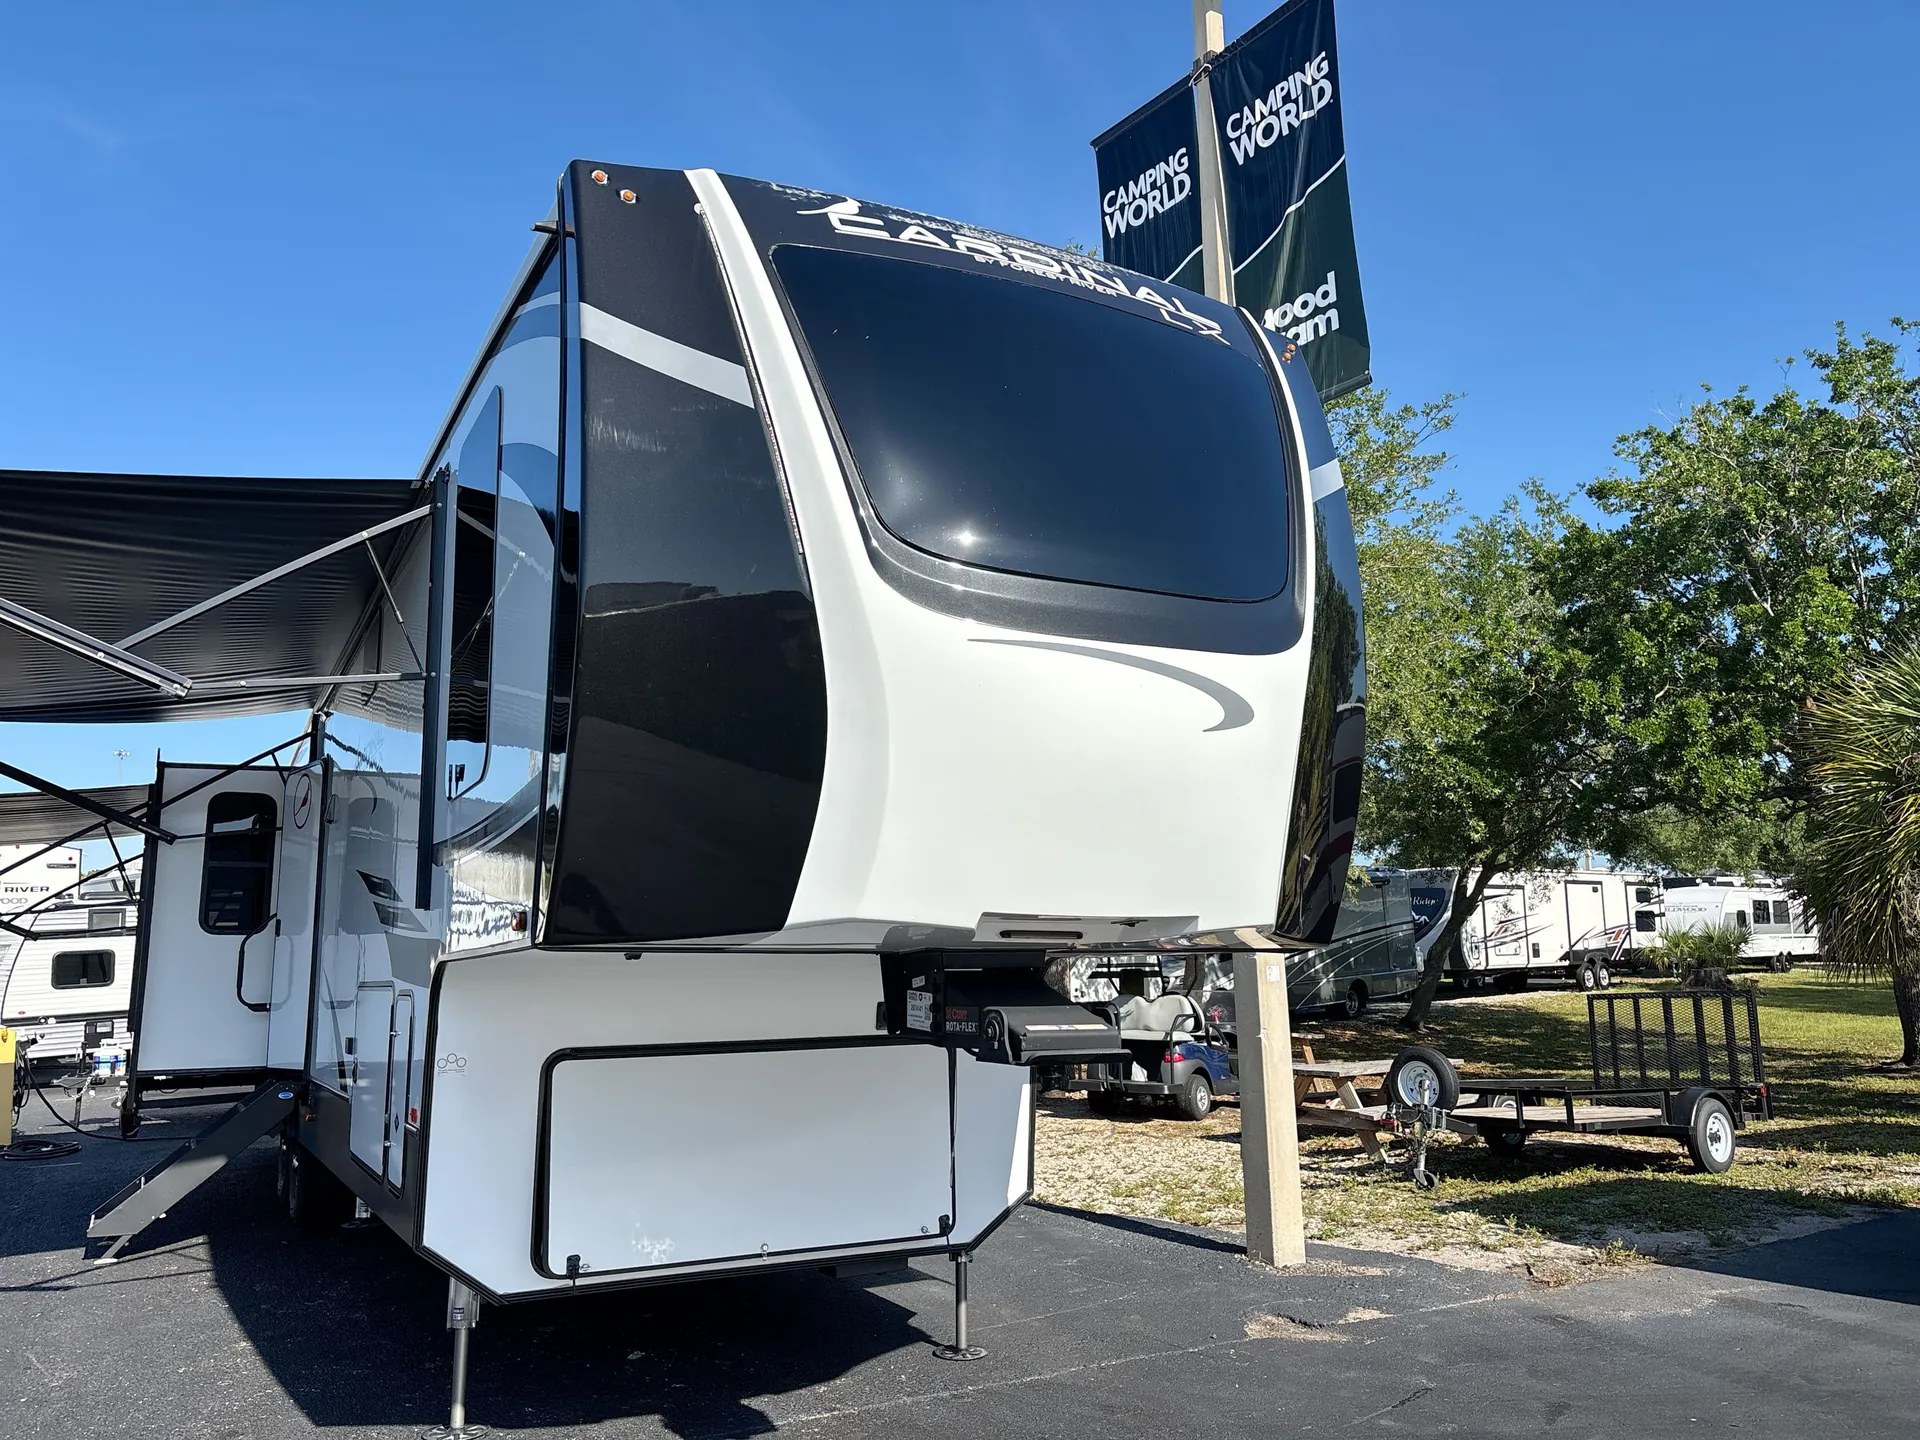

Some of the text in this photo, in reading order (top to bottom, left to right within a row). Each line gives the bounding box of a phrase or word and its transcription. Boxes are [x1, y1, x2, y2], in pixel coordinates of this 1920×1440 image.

[1225, 50, 1330, 139] CAMPING
[1229, 78, 1332, 166] WORLD
[1103, 146, 1189, 214] CAMPING
[1104, 172, 1191, 239] WORLD
[826, 209, 1222, 331] CARDINAL
[974, 254, 1118, 298] BY FOREST RIVER
[1280, 308, 1340, 346] am
